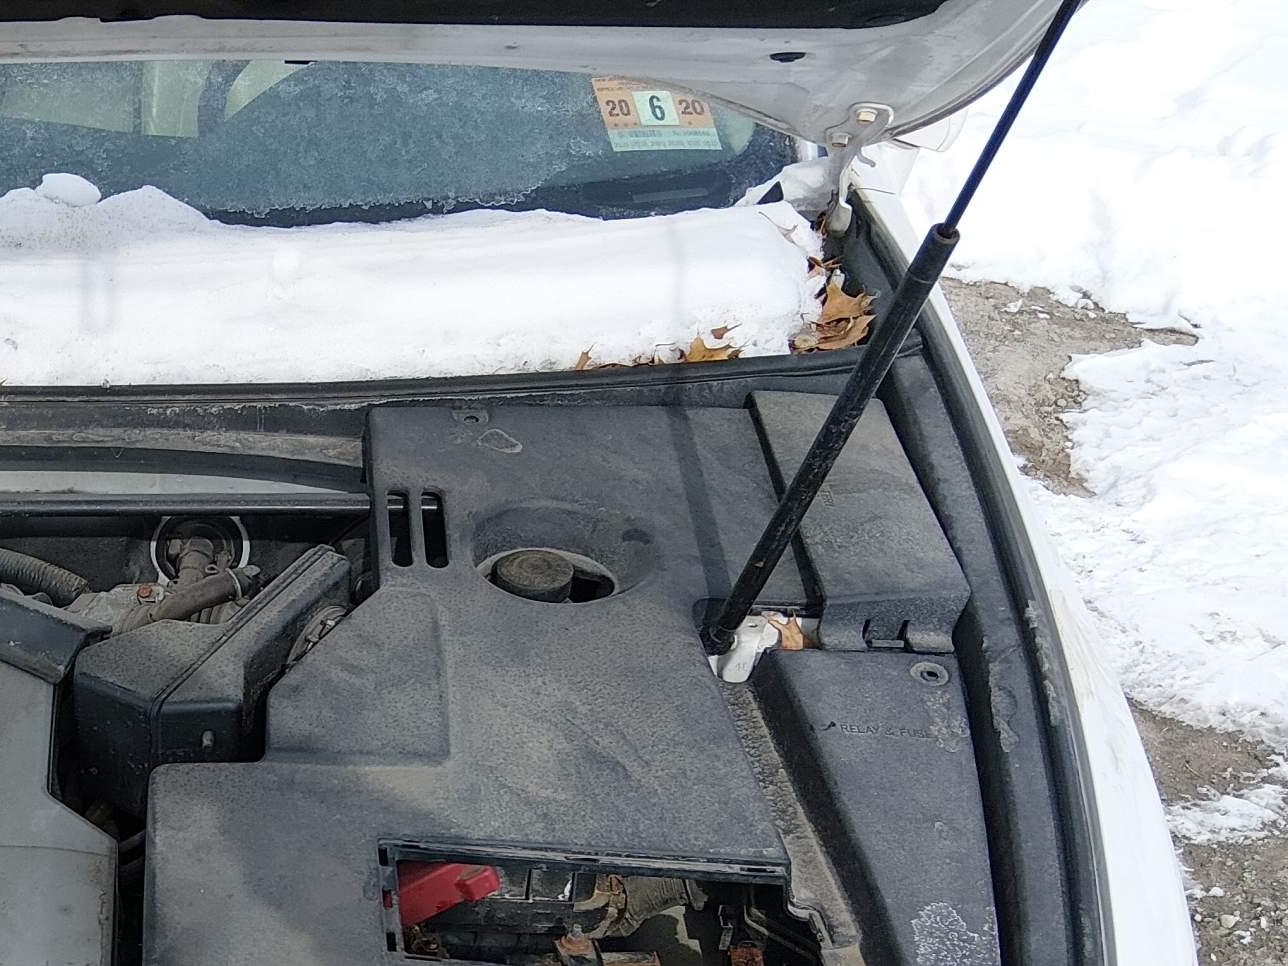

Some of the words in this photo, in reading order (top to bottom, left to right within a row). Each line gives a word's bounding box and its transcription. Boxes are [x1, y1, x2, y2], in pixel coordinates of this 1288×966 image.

[605, 98, 631, 117] 20
[648, 94, 666, 121] 6
[678, 98, 705, 116] 20
[840, 723, 880, 735] RELAY
